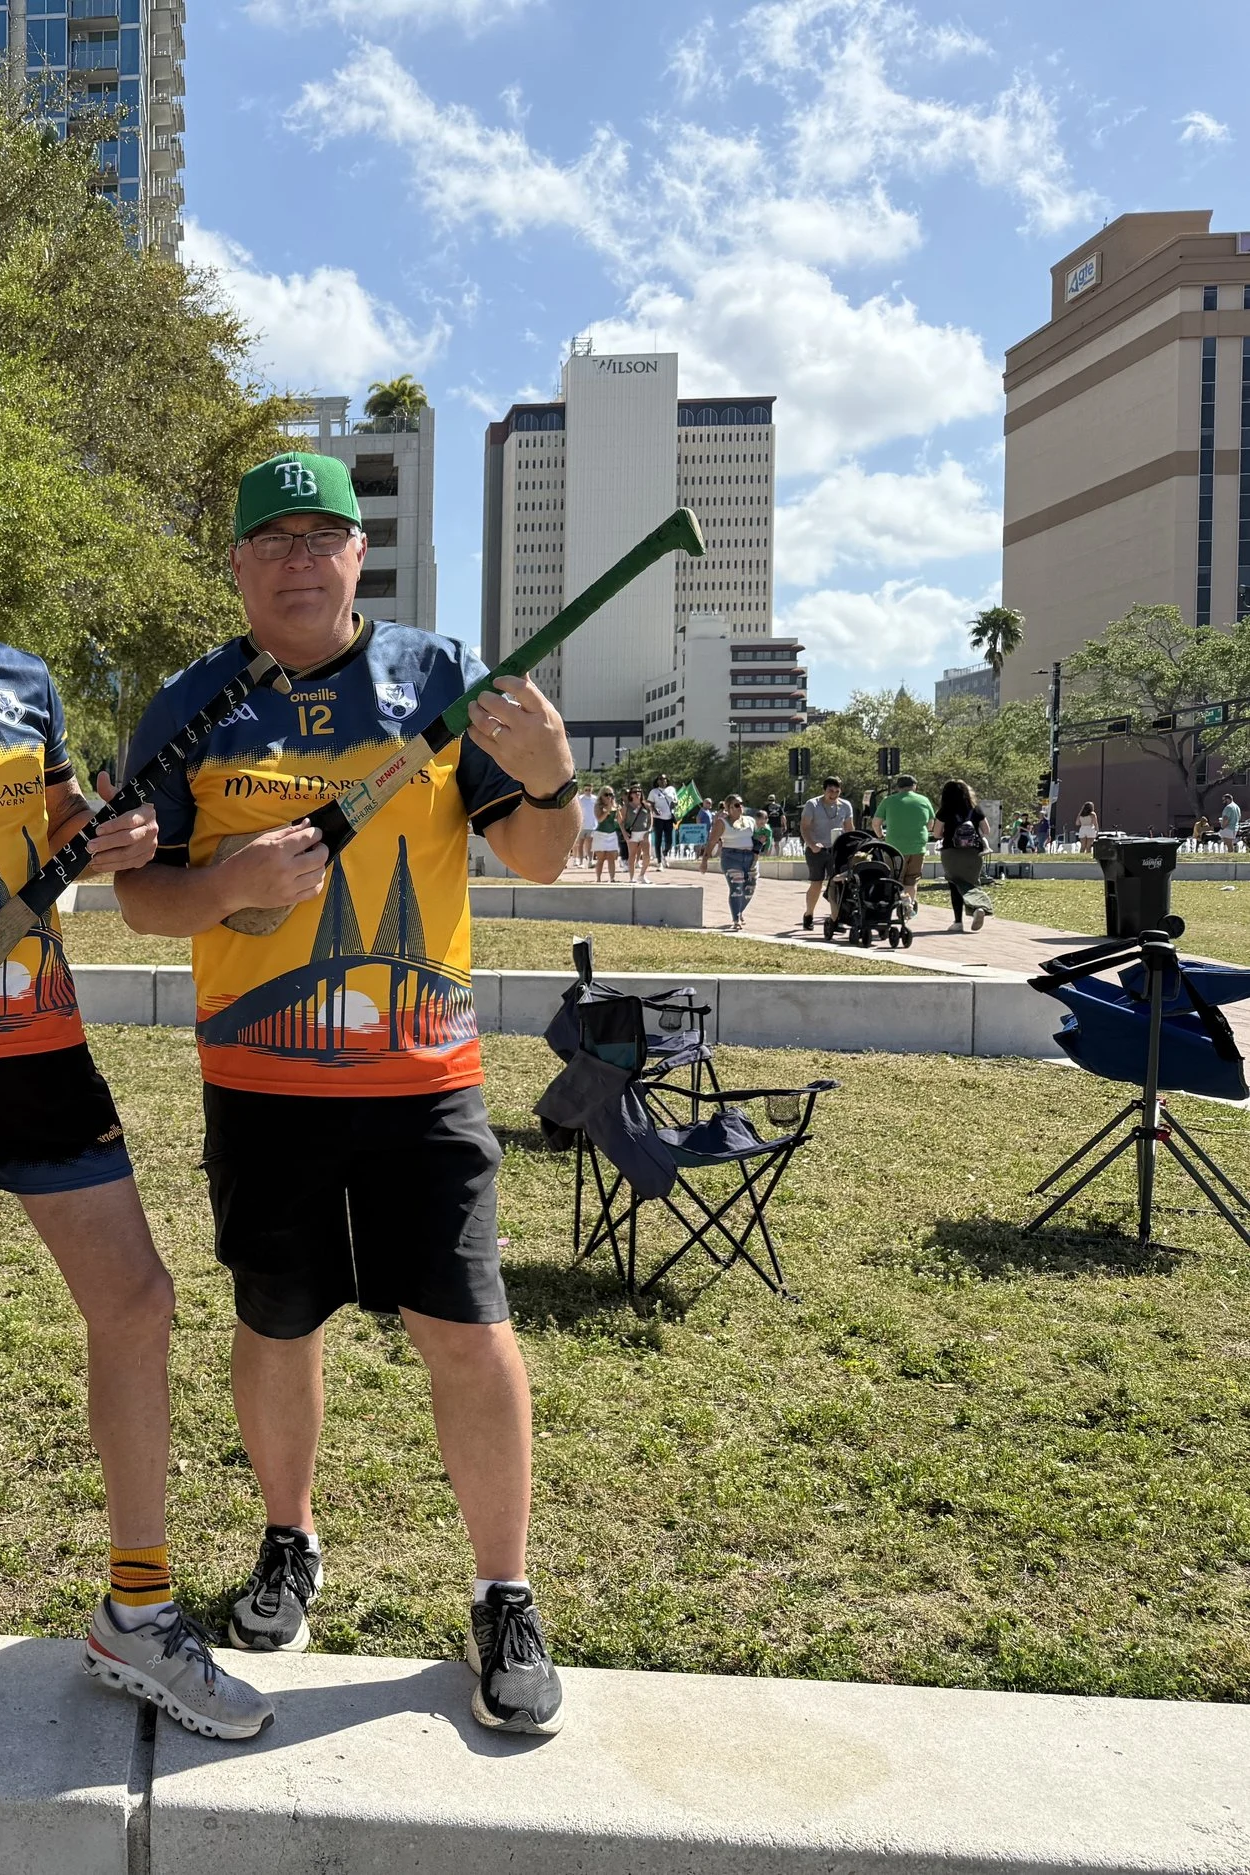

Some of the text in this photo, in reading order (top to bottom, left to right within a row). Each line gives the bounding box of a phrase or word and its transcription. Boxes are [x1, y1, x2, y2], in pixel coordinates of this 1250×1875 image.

[592, 359, 658, 374] WILSON
[274, 461, 318, 497] TB
[298, 704, 335, 736] 12
[375, 755, 407, 788] DENOVI
